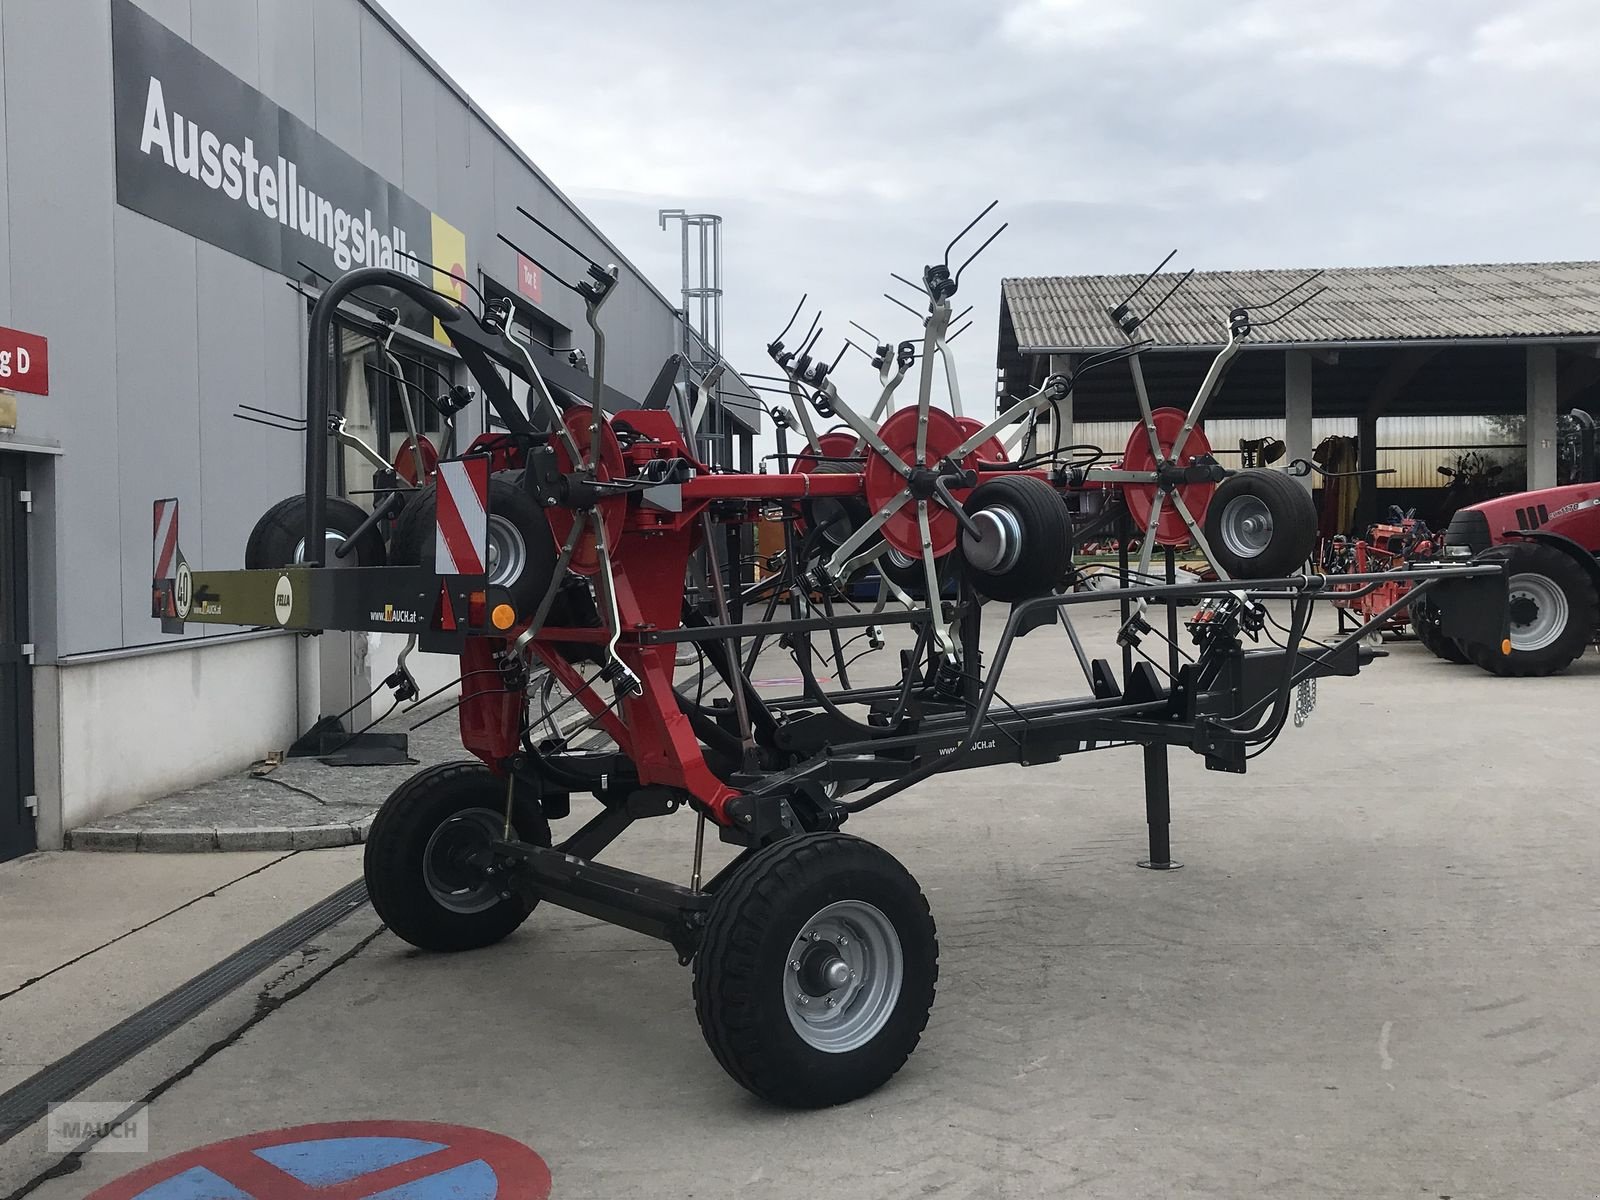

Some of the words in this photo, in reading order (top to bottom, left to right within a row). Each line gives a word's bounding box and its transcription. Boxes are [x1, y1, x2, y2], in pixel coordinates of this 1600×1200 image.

[140, 76, 419, 278] Ausstellungshalle
[17, 346, 30, 374] D
[370, 609, 417, 623] www.MAUCH.at
